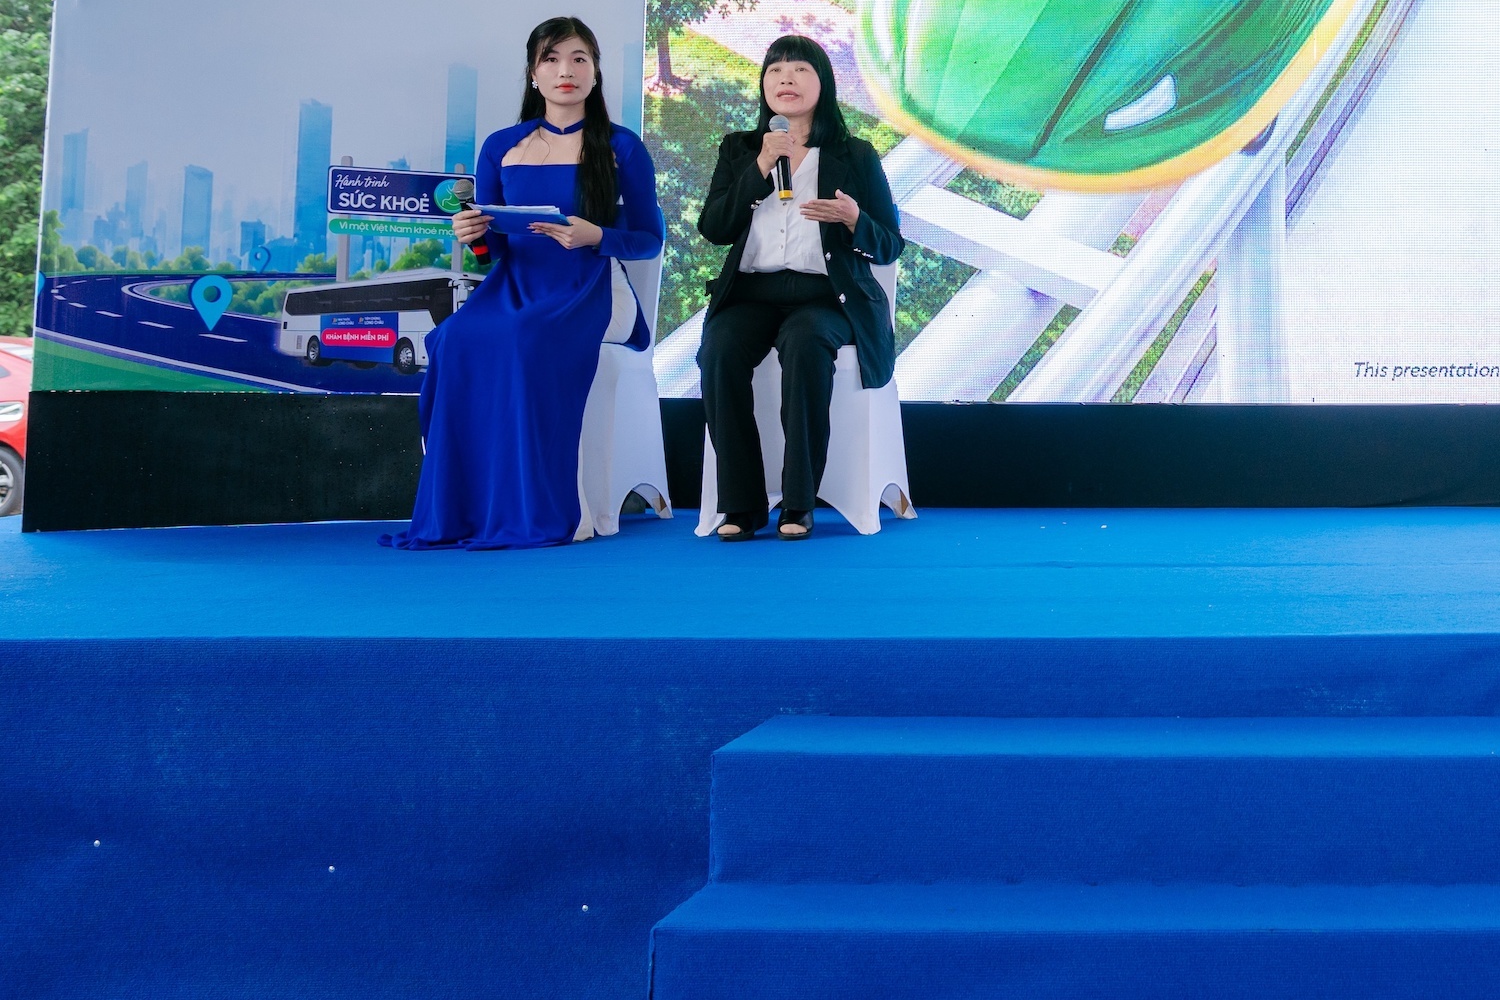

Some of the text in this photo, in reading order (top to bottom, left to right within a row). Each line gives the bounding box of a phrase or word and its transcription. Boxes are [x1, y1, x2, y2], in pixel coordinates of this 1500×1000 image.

[338, 189, 430, 213] SỨC KHOẺ
[1354, 362, 1388, 378] This
[1391, 363, 1500, 381] presentation
